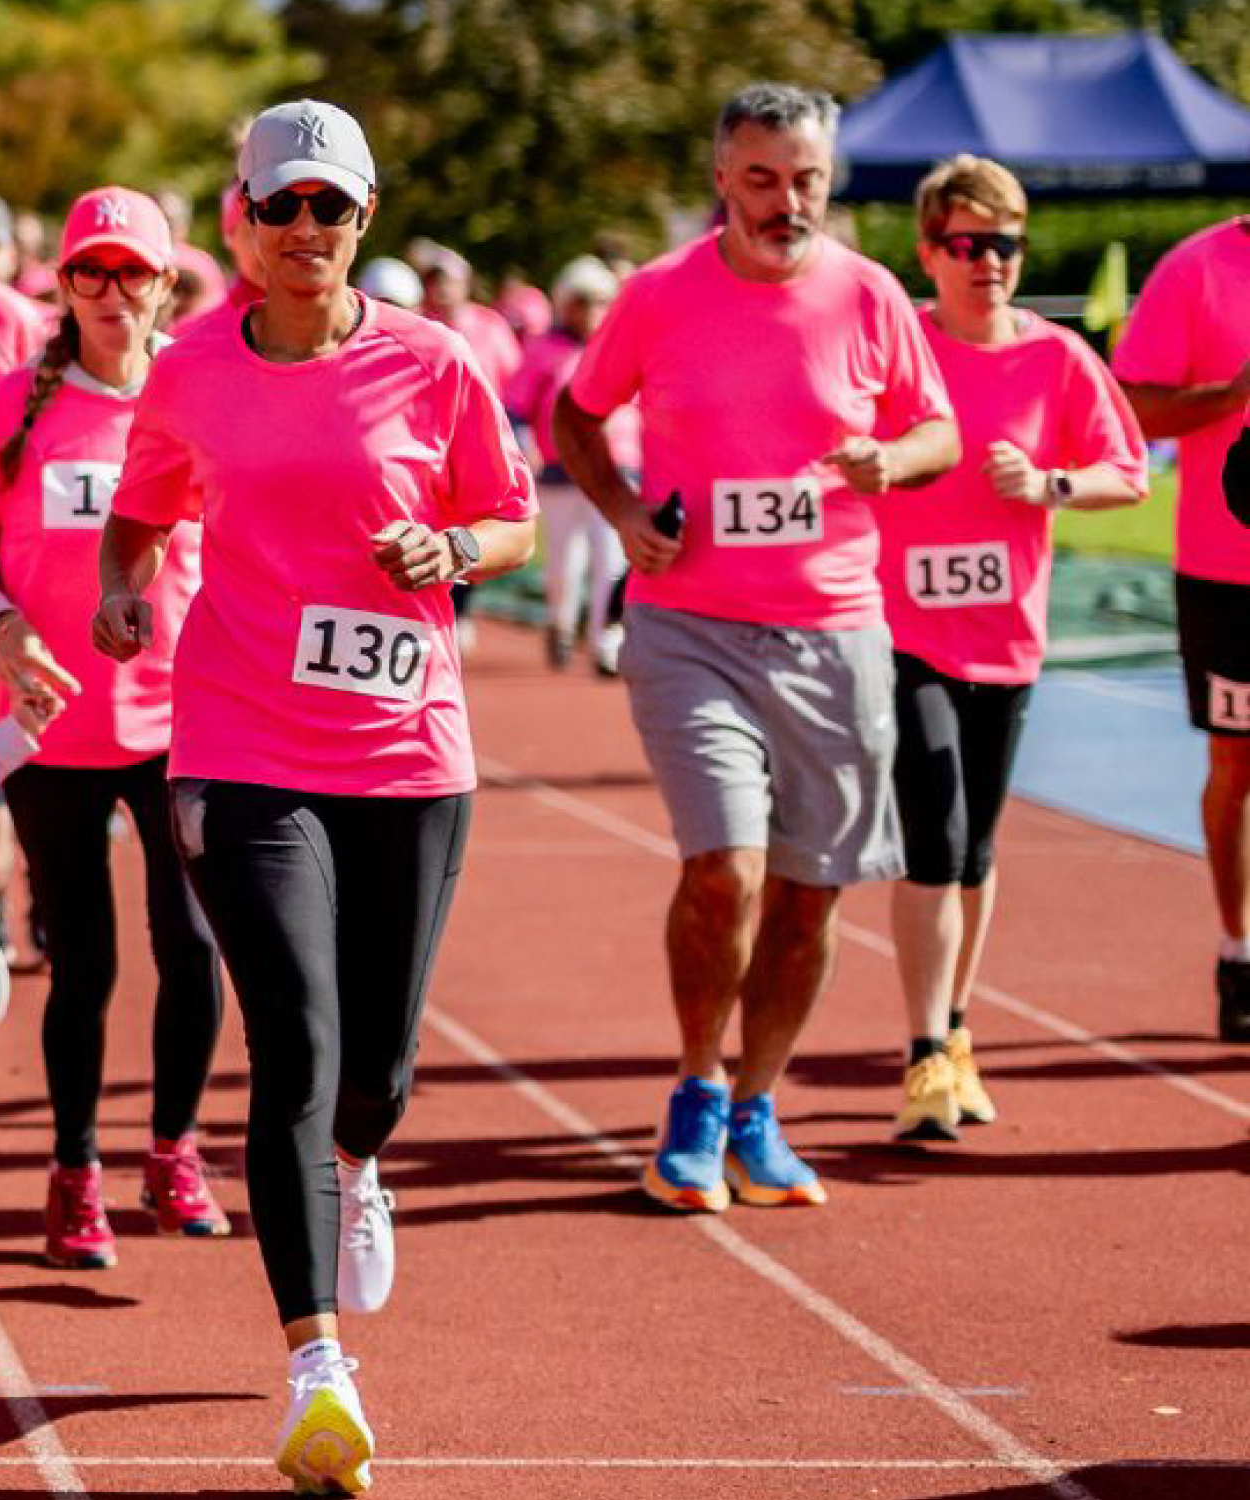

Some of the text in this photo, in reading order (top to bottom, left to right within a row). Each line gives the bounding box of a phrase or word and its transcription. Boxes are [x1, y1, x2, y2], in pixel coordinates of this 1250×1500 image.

[295, 113, 327, 147] NY
[71, 474, 120, 516] 1
[723, 491, 817, 534] 134
[917, 553, 1002, 597] 158
[306, 619, 420, 686] 130
[1221, 690, 1250, 718] 1
